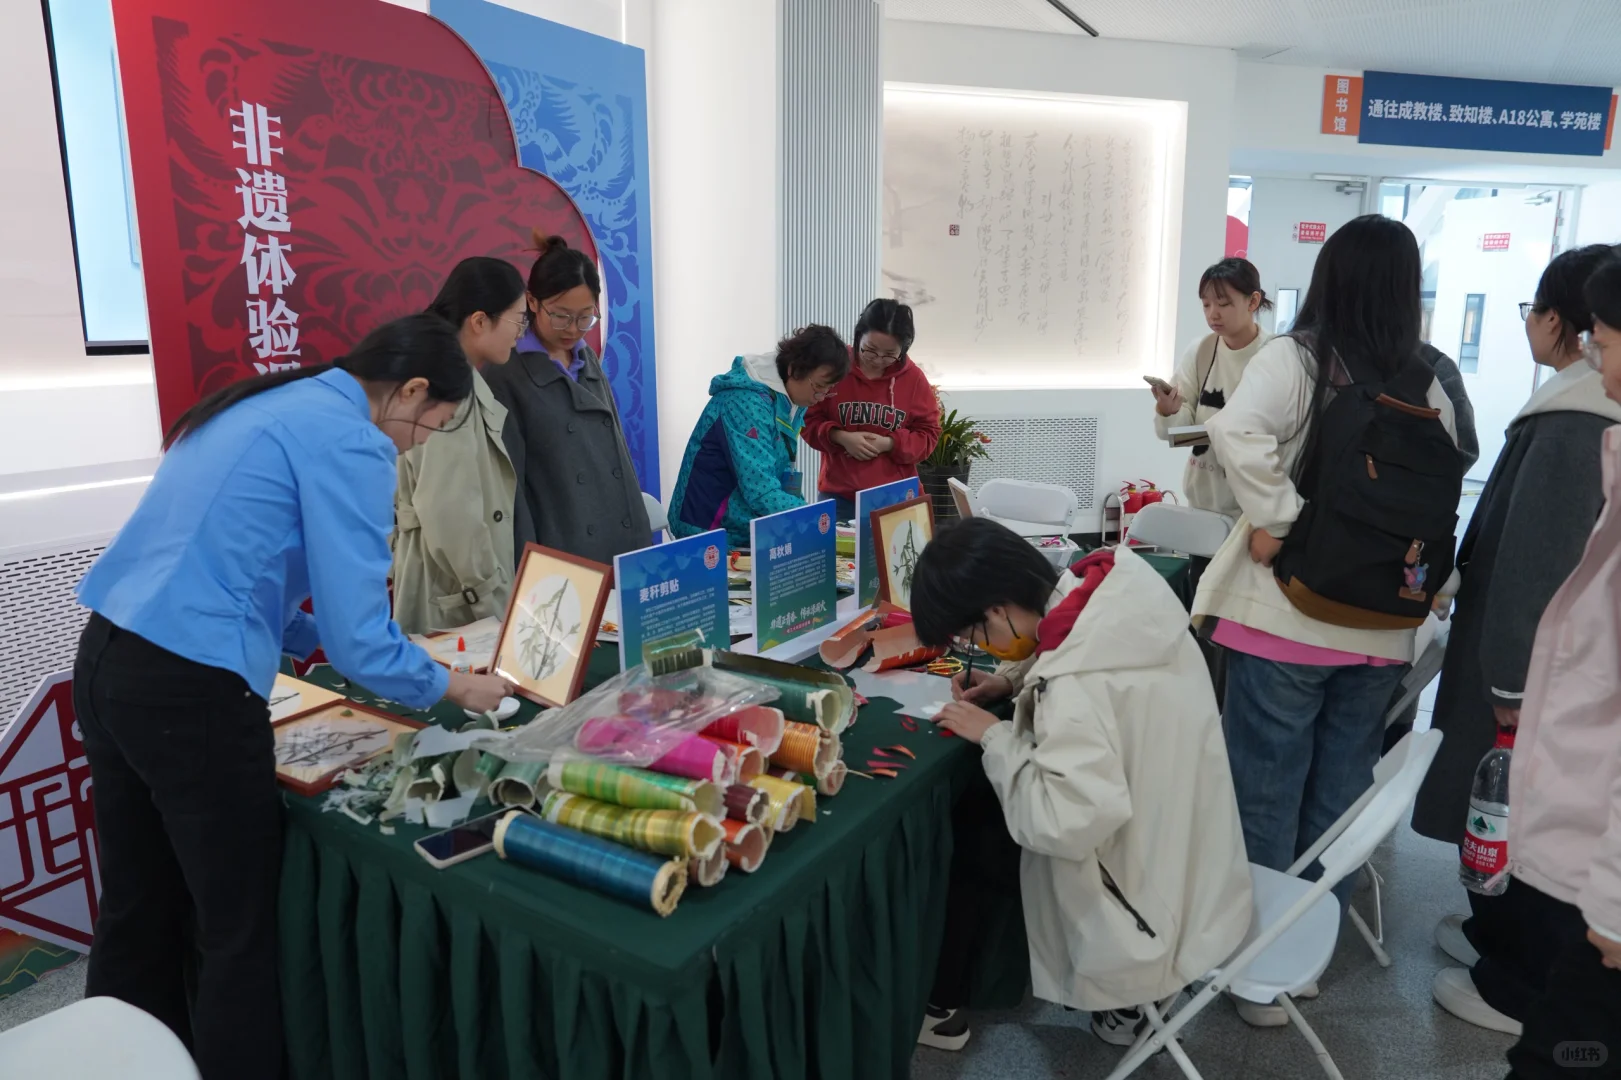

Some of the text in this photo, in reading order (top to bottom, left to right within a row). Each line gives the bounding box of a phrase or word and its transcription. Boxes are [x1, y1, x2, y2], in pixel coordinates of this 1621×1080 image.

[1334, 78, 1350, 132] 图书馆
[838, 401, 907, 432] VENICE
[639, 578, 680, 603] 麦秆剪贴
[1464, 837, 1499, 857] 农夫山泉
